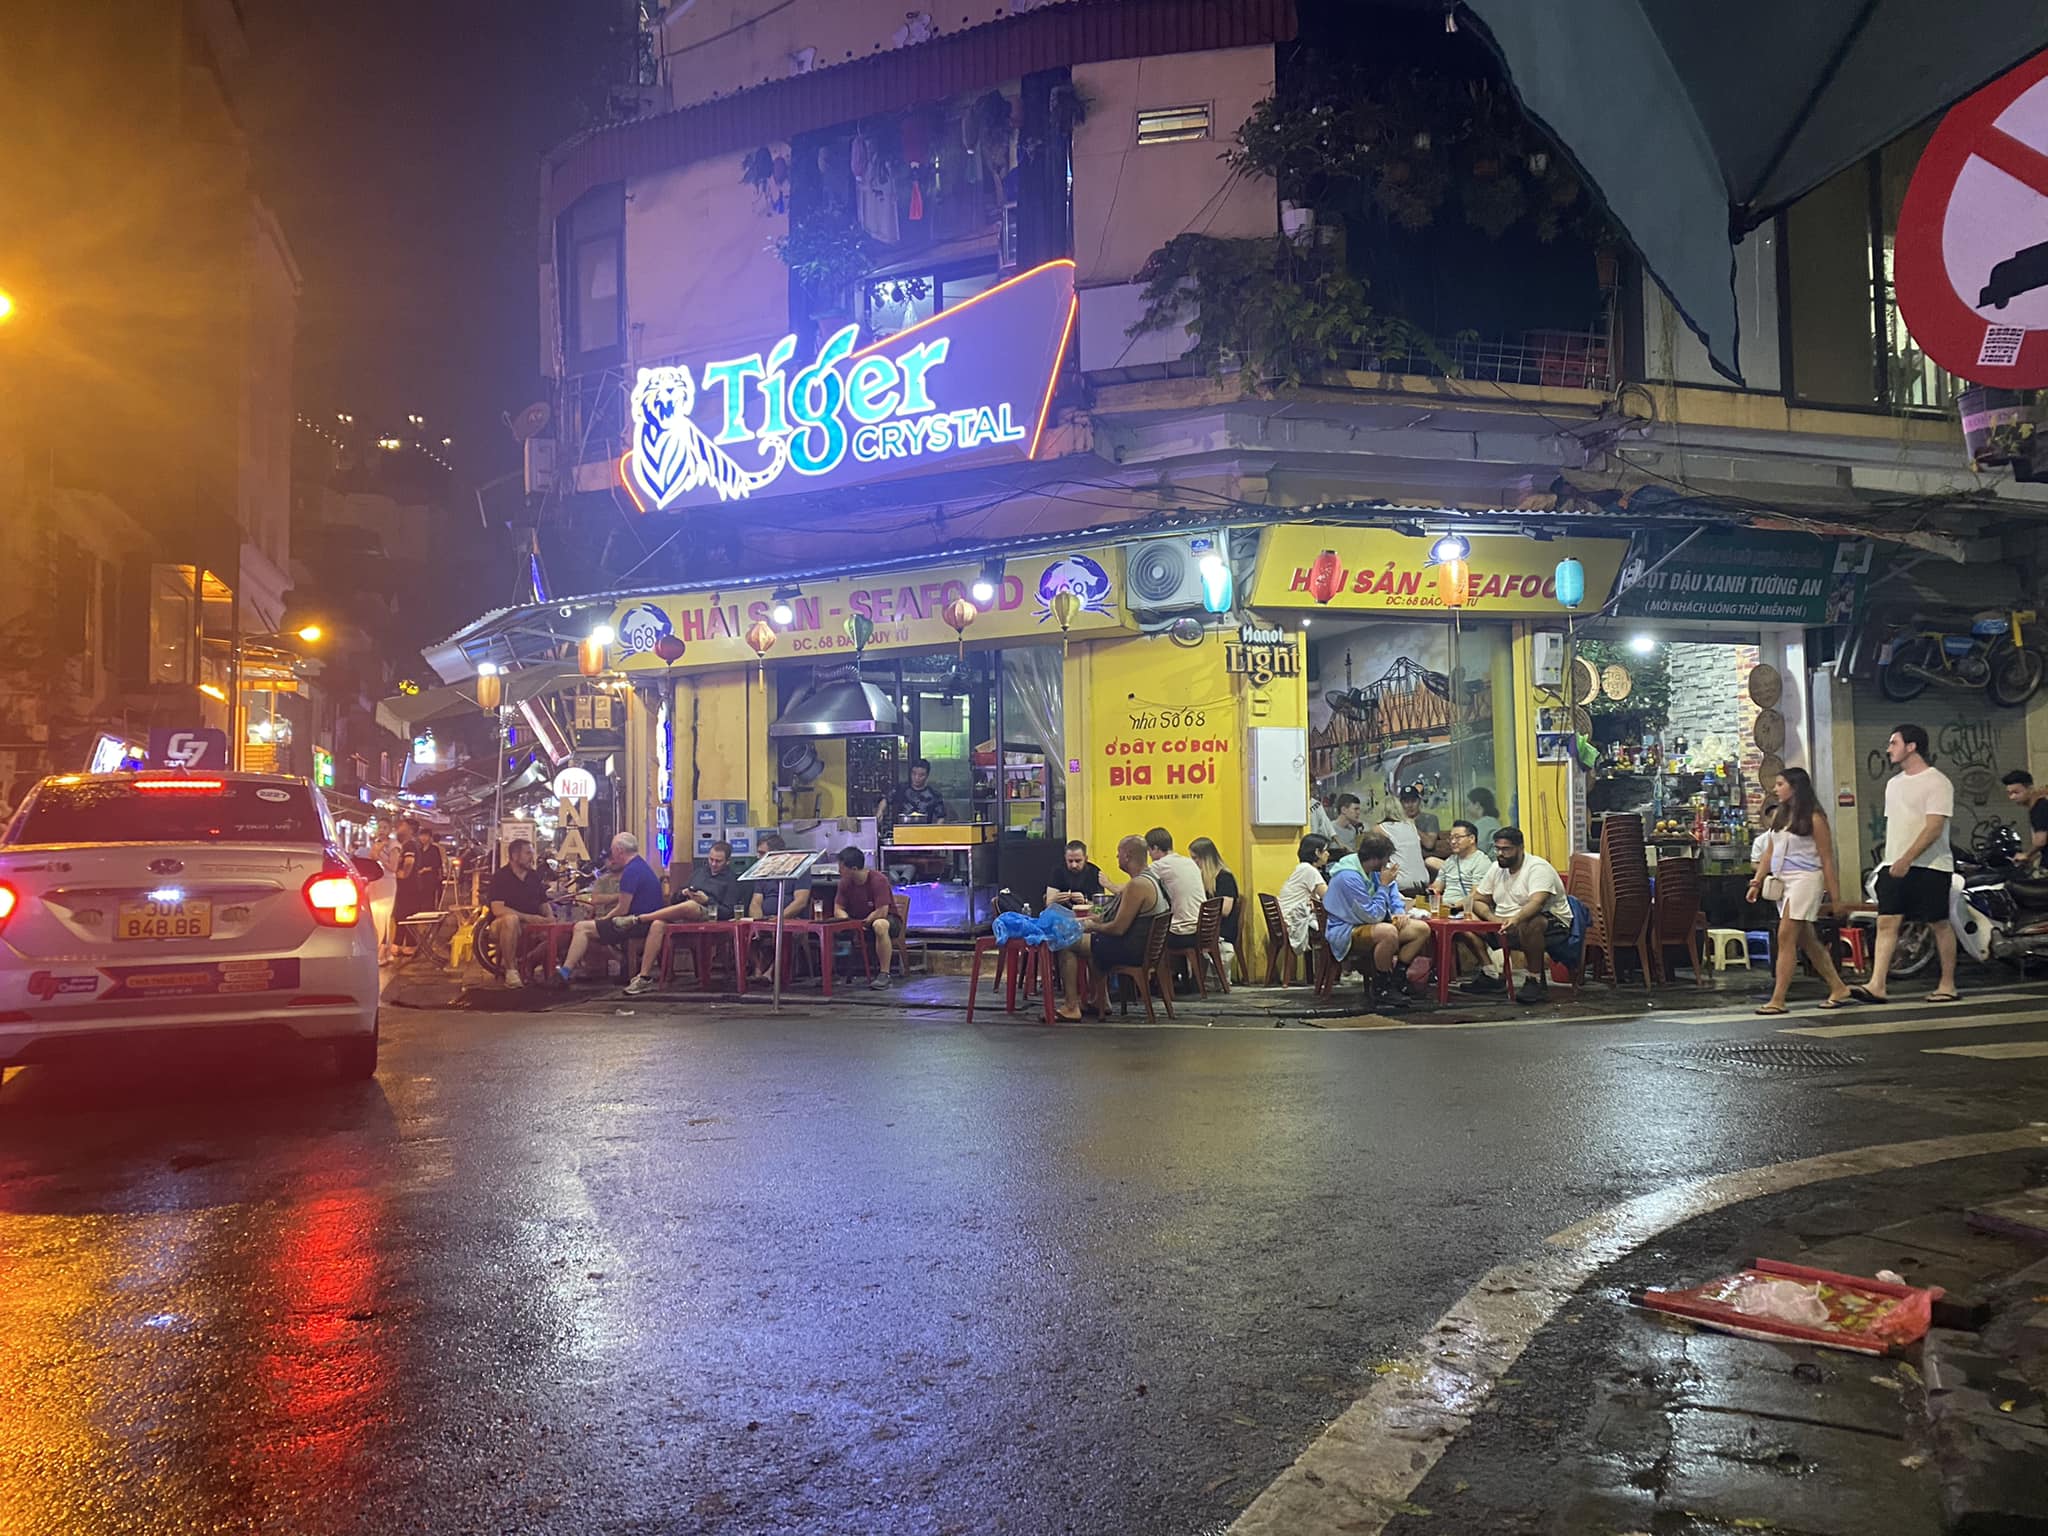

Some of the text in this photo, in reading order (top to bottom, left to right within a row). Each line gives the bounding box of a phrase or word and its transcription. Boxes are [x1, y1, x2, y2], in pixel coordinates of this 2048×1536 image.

[702, 323, 950, 476] Tiger
[852, 403, 1025, 462] CRYSTAL
[1288, 568, 1349, 593] HI
[1353, 561, 1422, 595] SẢN
[1703, 575, 1747, 594] XANH
[1800, 578, 1823, 596] AN
[682, 591, 740, 642] HẢI
[850, 575, 1024, 625] SEAFOD
[1672, 600, 1707, 613] KHÁCH
[633, 627, 655, 650] 68
[1224, 641, 1301, 684] Light
[1184, 711, 1206, 727] 68
[168, 733, 208, 767] G7
[561, 779, 588, 795] Nail
